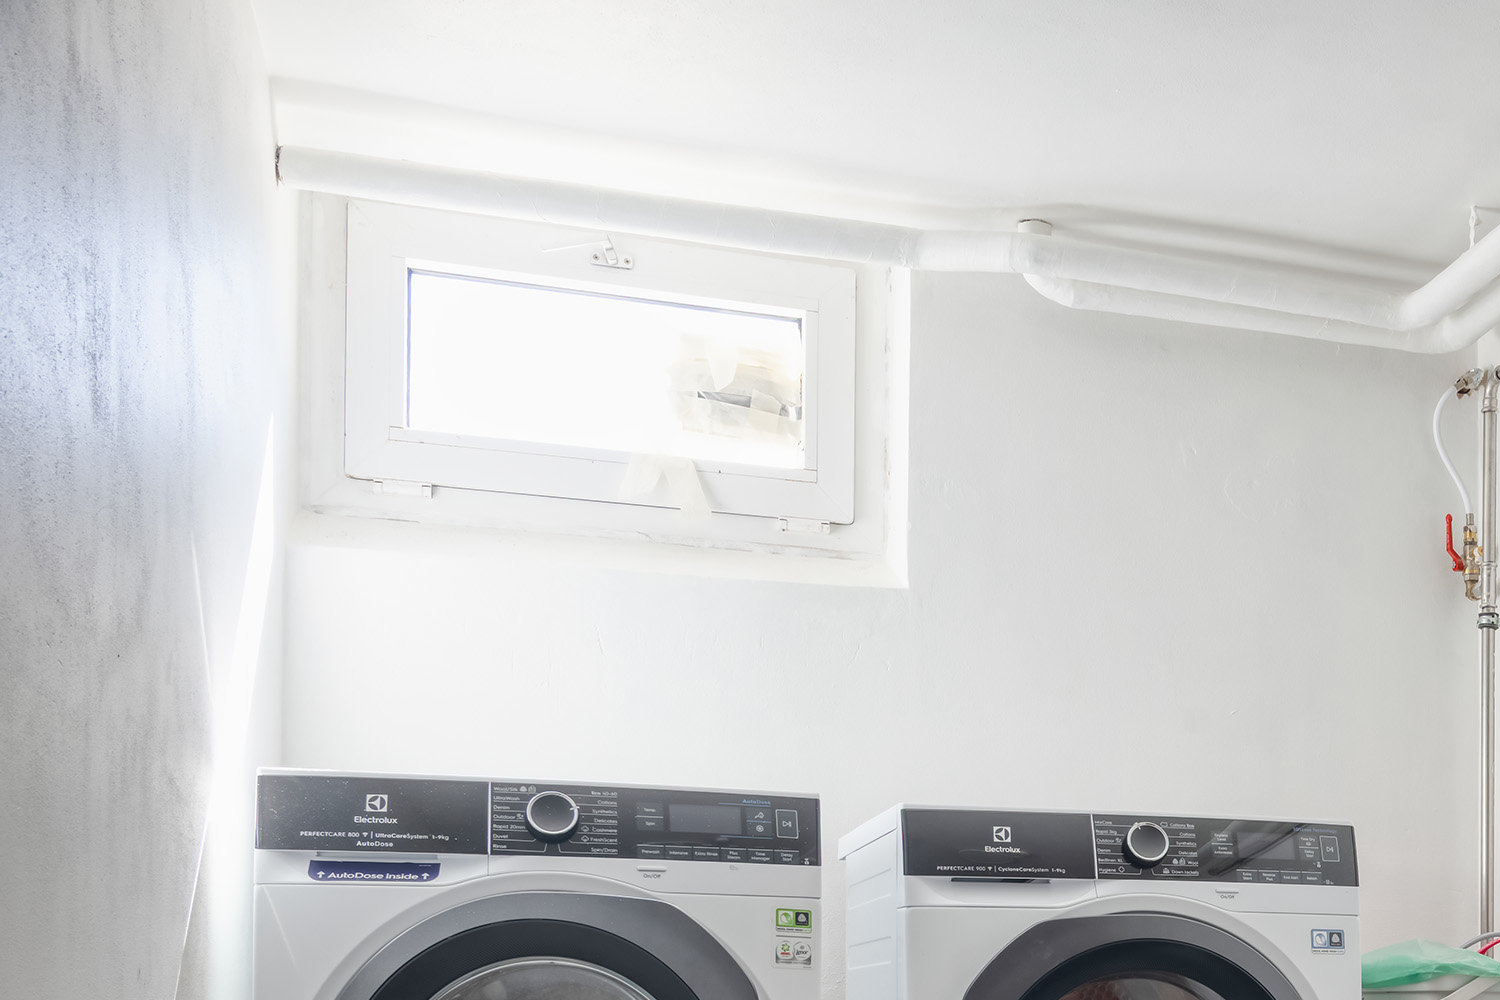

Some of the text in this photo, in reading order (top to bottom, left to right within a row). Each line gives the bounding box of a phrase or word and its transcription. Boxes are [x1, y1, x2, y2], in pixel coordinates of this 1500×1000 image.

[354, 815, 398, 825] Electrolux
[375, 832, 429, 840] UltraCareSystem
[984, 845, 1021, 853] Electrolux
[327, 871, 384, 880] AutoDose
